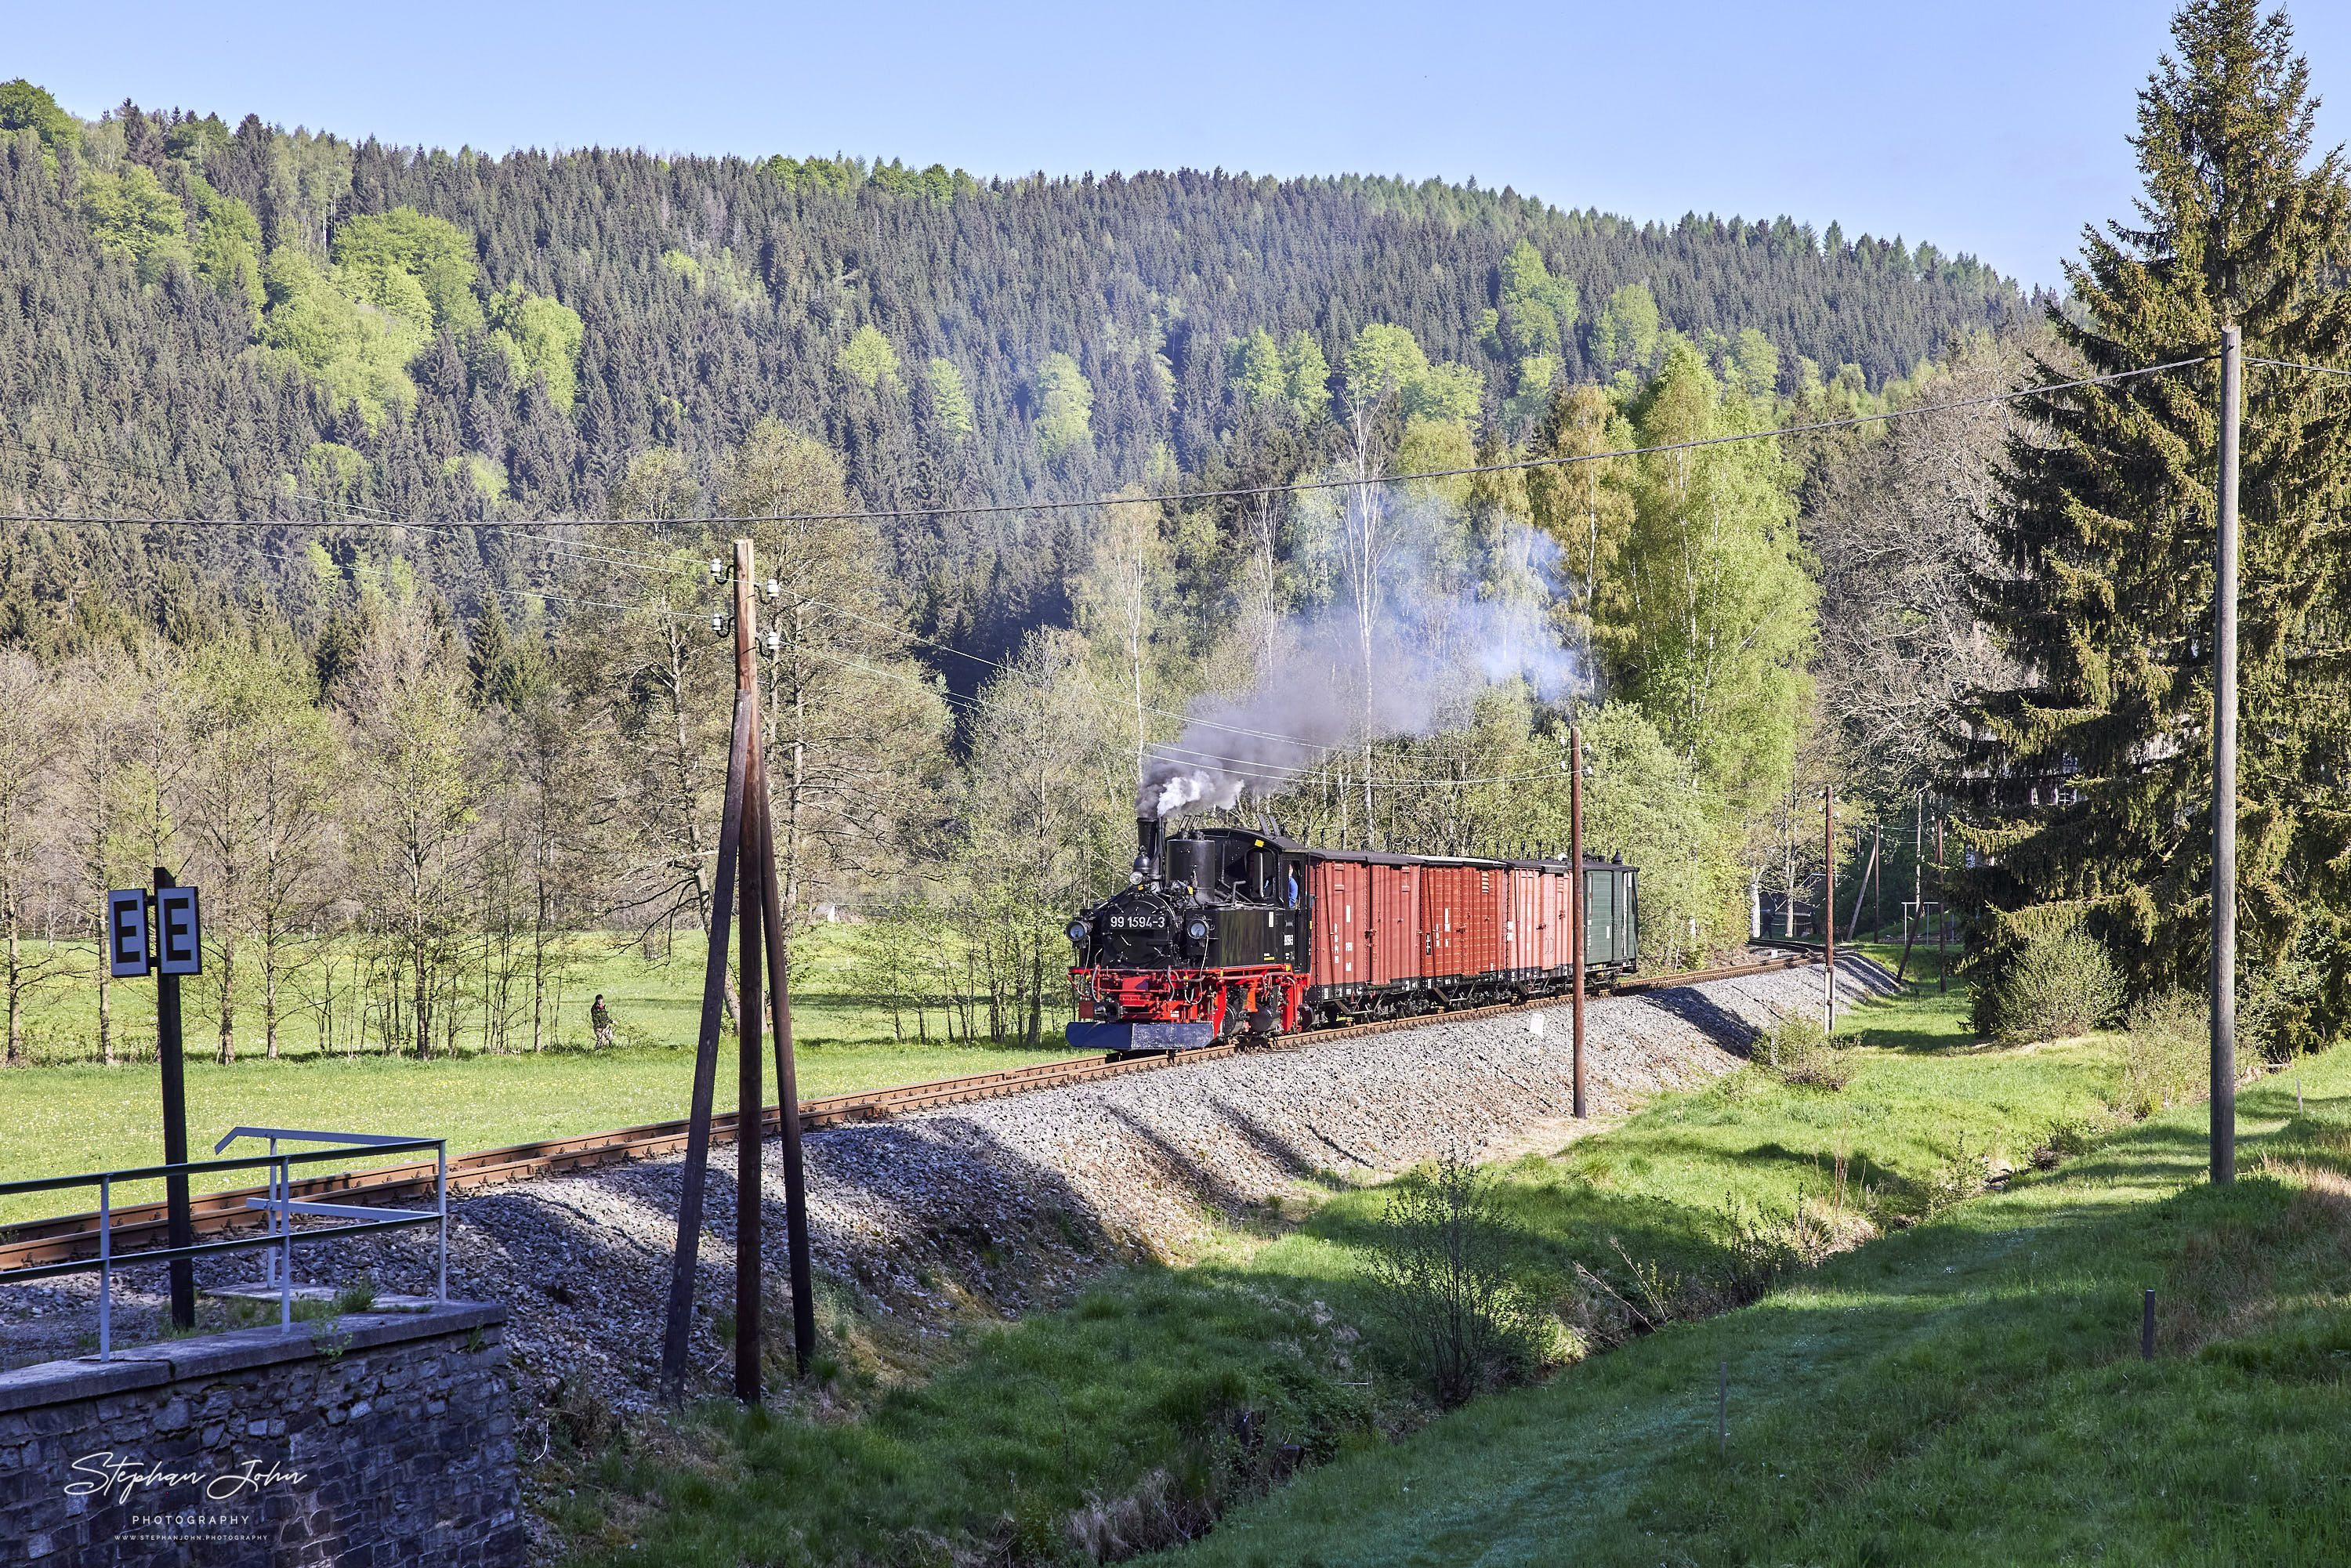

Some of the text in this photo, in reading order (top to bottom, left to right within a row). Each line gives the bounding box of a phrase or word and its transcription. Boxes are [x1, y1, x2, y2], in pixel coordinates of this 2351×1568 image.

[114, 898, 191, 963] E E
[1110, 916, 1165, 928] 99 1594-3
